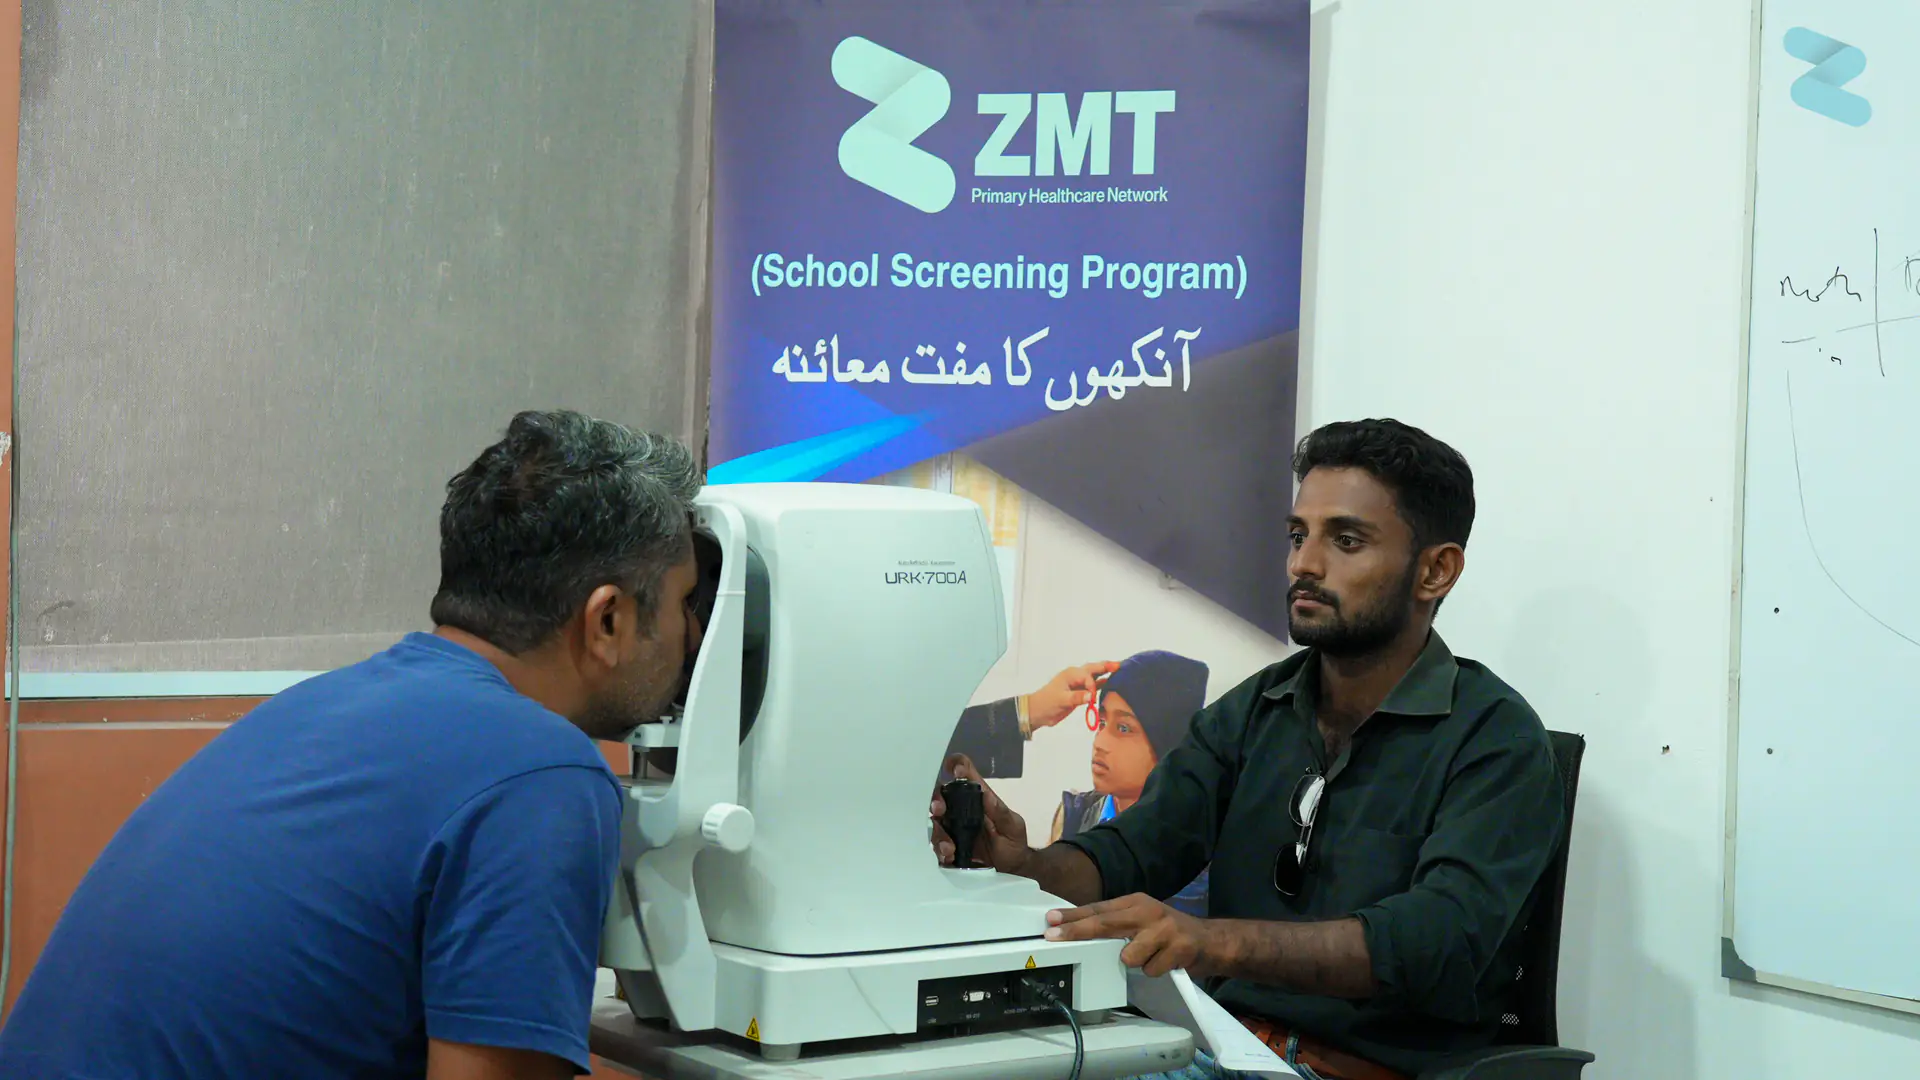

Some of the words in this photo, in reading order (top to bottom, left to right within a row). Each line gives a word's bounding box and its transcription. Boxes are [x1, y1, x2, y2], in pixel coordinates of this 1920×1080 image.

[975, 90, 1175, 176] ZMT
[971, 187, 1027, 207] Primary
[1028, 187, 1105, 204] Healthcare
[1107, 186, 1169, 203] Network
[751, 252, 879, 296] (School
[891, 253, 1068, 298] Screening
[1083, 255, 1248, 299] Program)
[901, 341, 992, 386] مفت
[1003, 327, 1049, 386] کا
[1045, 327, 1202, 411] آنکھوں
